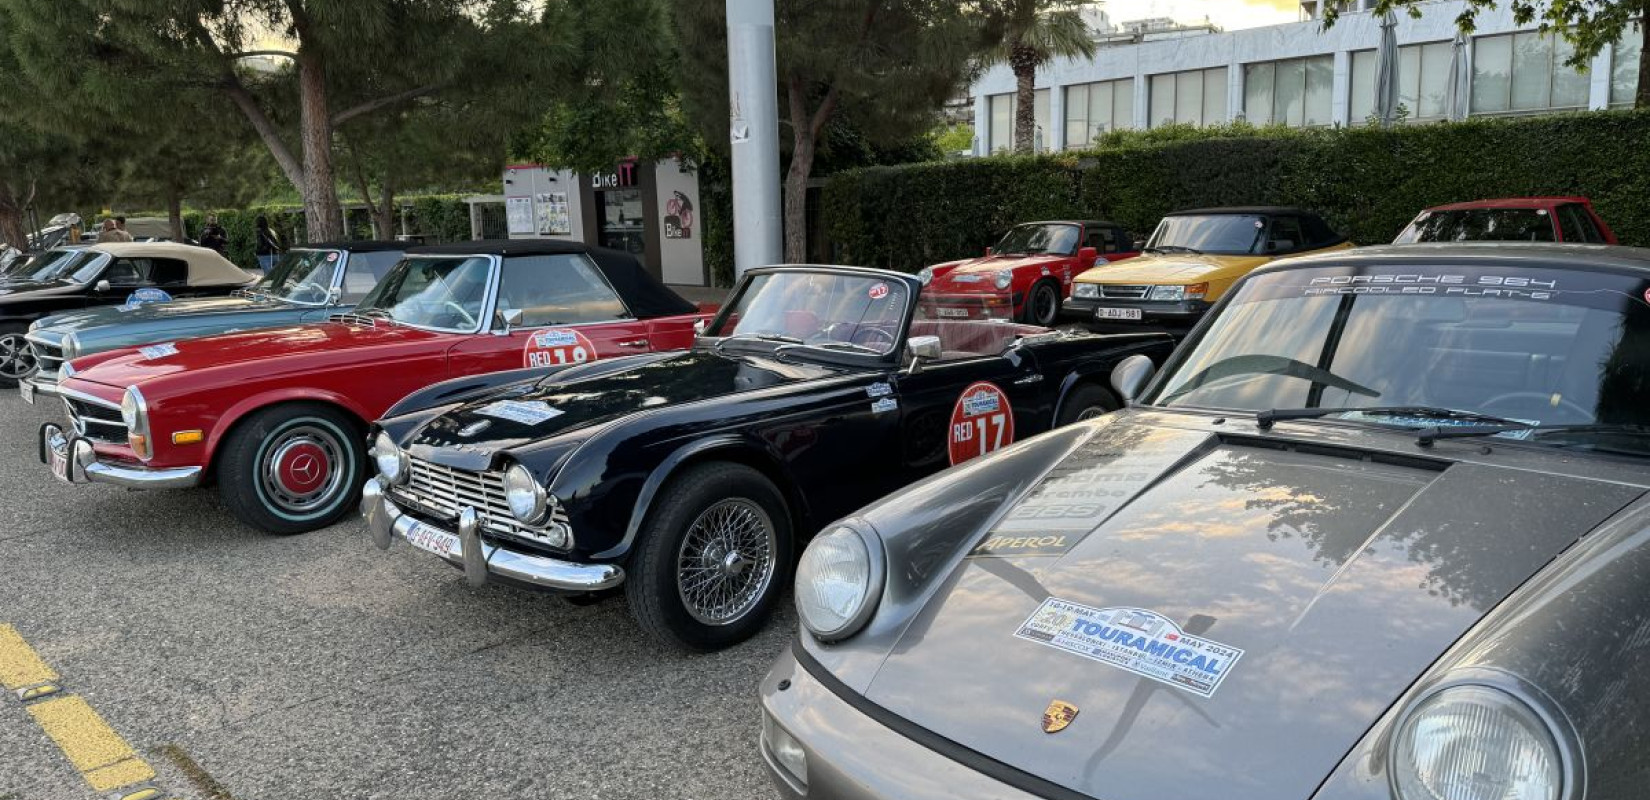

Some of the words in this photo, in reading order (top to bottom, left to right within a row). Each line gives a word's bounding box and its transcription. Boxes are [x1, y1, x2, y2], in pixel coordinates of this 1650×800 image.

[1309, 274, 1466, 285] PORSCHE
[1477, 275, 1556, 289] 964
[1304, 286, 1437, 296] AIRCOOLED
[528, 351, 551, 367] RED
[953, 421, 973, 443] RED
[976, 413, 1006, 457] 17
[976, 535, 1066, 550] APEROL
[1072, 618, 1221, 675] TOURAMICAL
[1180, 637, 1205, 649] MAY
[1205, 645, 1235, 658] 2024
